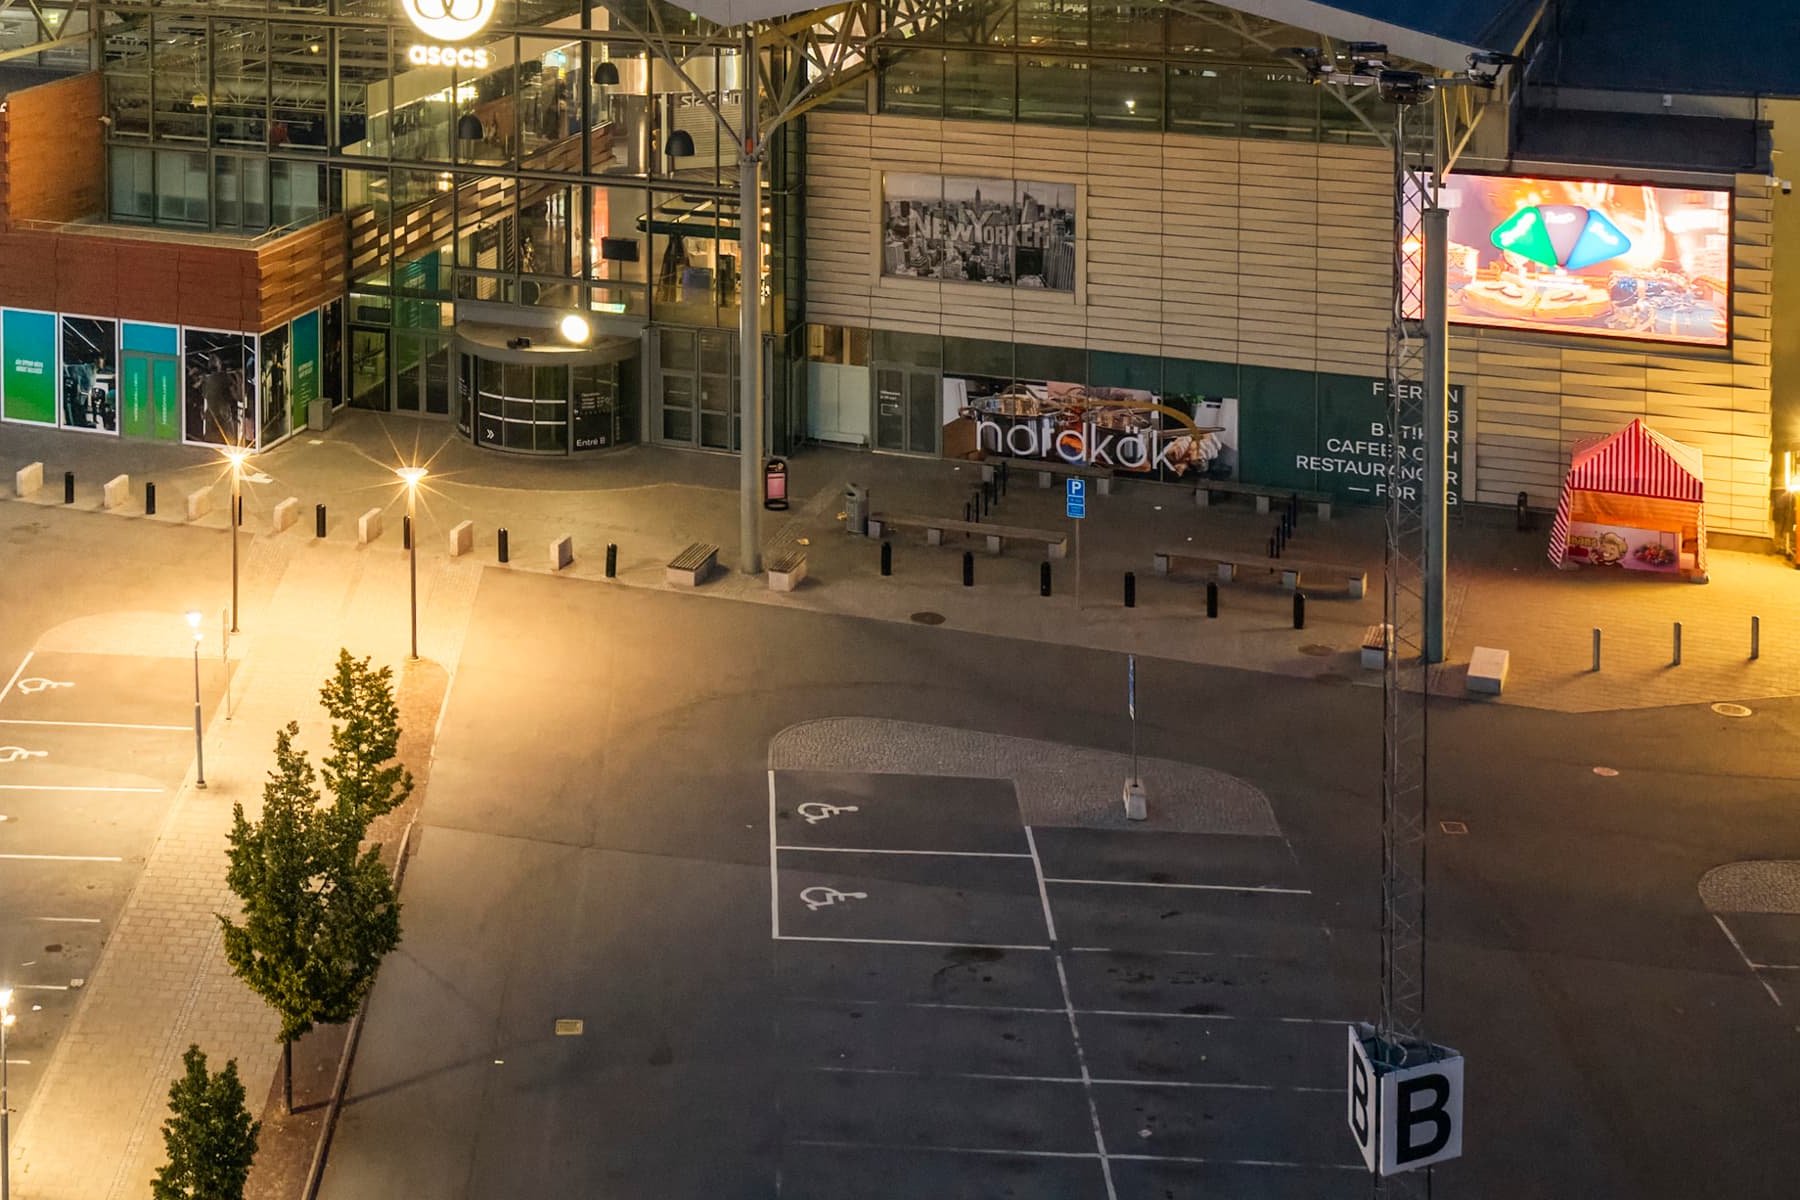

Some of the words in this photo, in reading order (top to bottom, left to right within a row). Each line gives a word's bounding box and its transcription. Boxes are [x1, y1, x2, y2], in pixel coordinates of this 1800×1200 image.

[976, 420, 1176, 472] nordkök
[1072, 481, 1081, 494] P
[1352, 1044, 1368, 1147] B
[1397, 1073, 1452, 1165] B
